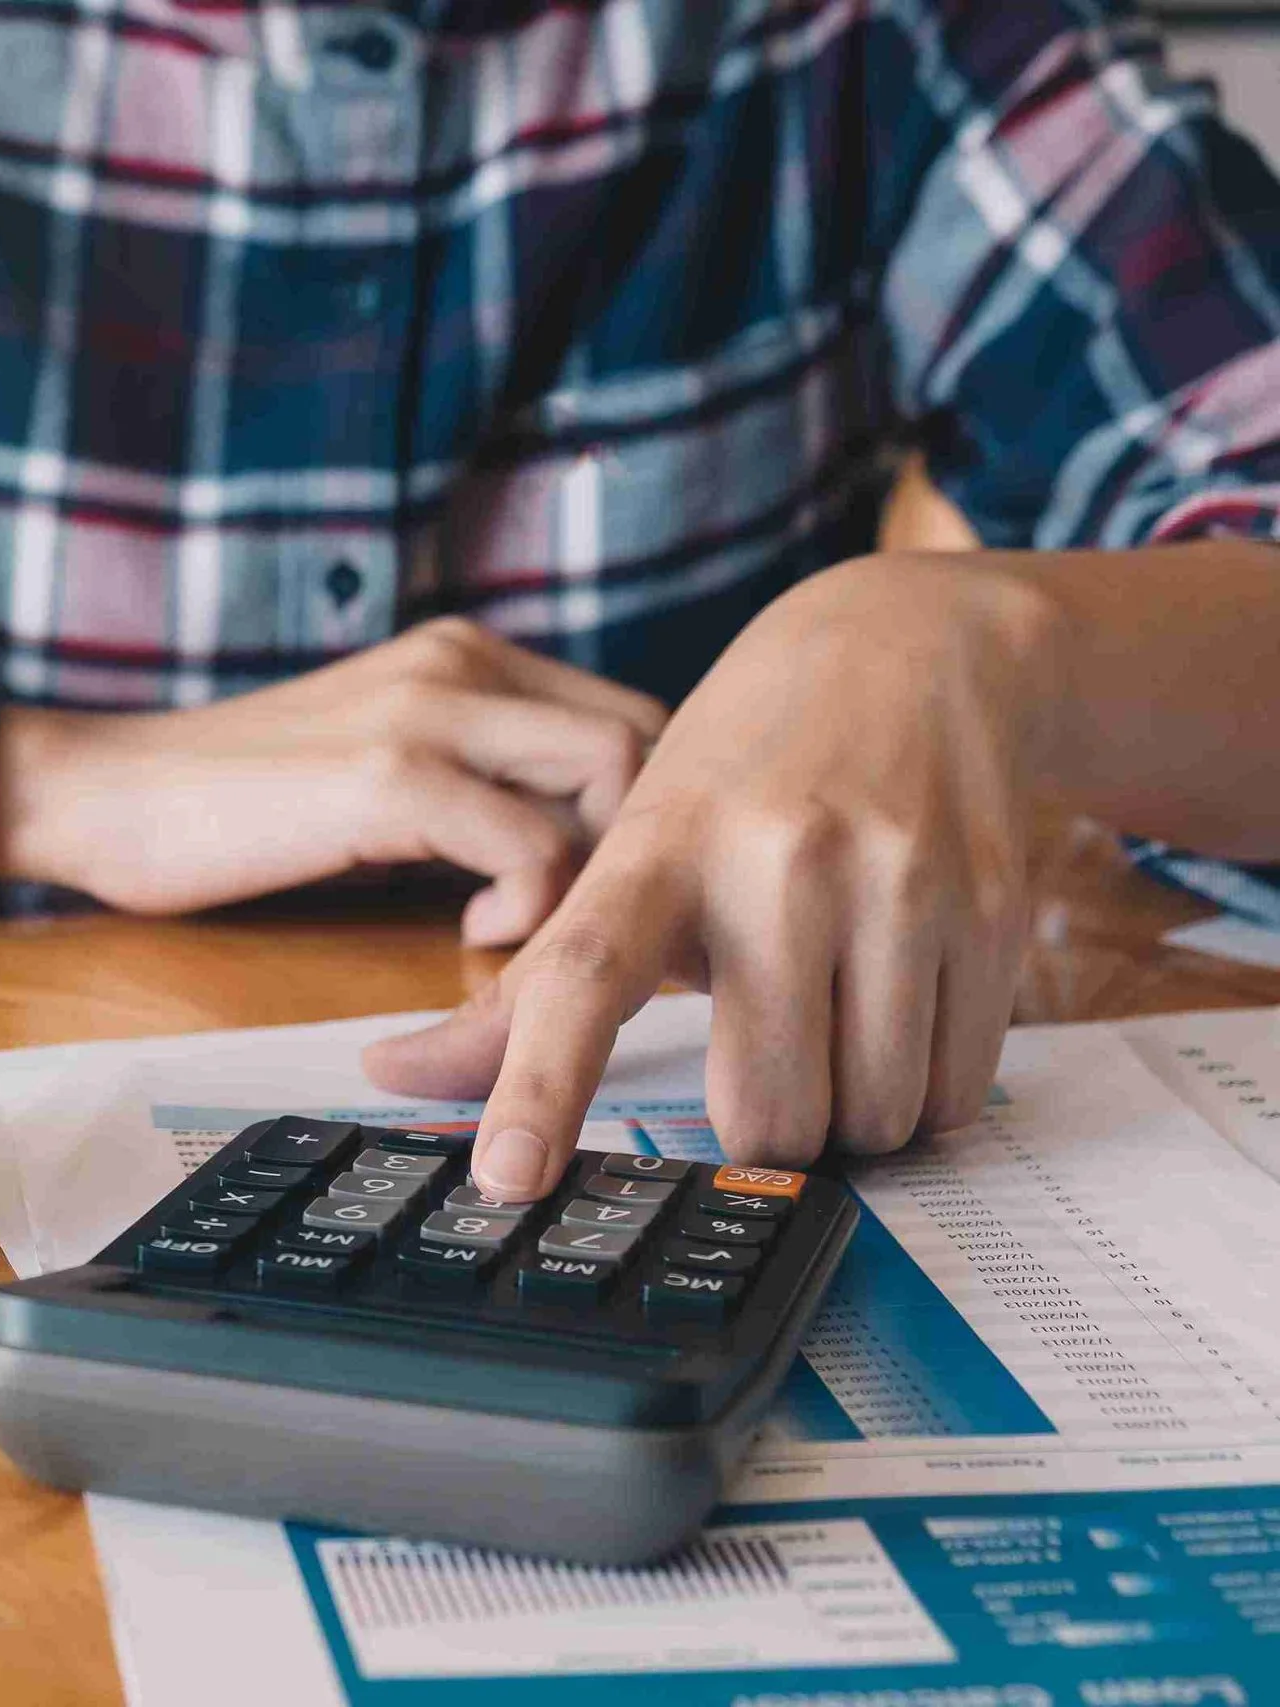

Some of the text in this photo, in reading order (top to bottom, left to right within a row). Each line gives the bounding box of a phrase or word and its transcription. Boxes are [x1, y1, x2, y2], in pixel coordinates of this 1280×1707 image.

[286, 1133, 320, 1145] +
[383, 1154, 418, 1170] 3
[726, 1170, 792, 1185] C/AC
[363, 1178, 395, 1193] 6
[620, 1181, 639, 1195] 1
[475, 1193, 503, 1209] 5
[334, 1204, 368, 1219] 9
[597, 1206, 630, 1221] 4
[452, 1217, 489, 1234] 8
[711, 1220, 746, 1235] %
[937, 1220, 1003, 1229] 1/5/2014
[298, 1230, 355, 1246] M+
[570, 1233, 604, 1248] 7
[947, 1230, 1013, 1240] 1/4/2014
[150, 1238, 219, 1254] OFF
[957, 1241, 1024, 1250] 1/3/2014
[276, 1253, 333, 1268] MU
[967, 1253, 1034, 1262] 1/2/2014
[540, 1258, 596, 1275] MR
[977, 1264, 1045, 1273] 1/1/2014
[663, 1273, 723, 1291] MC
[982, 1276, 1060, 1285] 1/12/2013
[992, 1287, 1071, 1296] 1/11/2013
[1003, 1299, 1082, 1308] 1/10/2013
[1018, 1311, 1089, 1321] 1/9/2013
[1030, 1324, 1100, 1333] 1/8/2013
[1041, 1337, 1112, 1347] 1/7/2013
[1053, 1350, 1124, 1359] 1/6/2013
[1064, 1363, 1136, 1372] 1/5/2013
[1075, 1376, 1147, 1385] 1/4/2013
